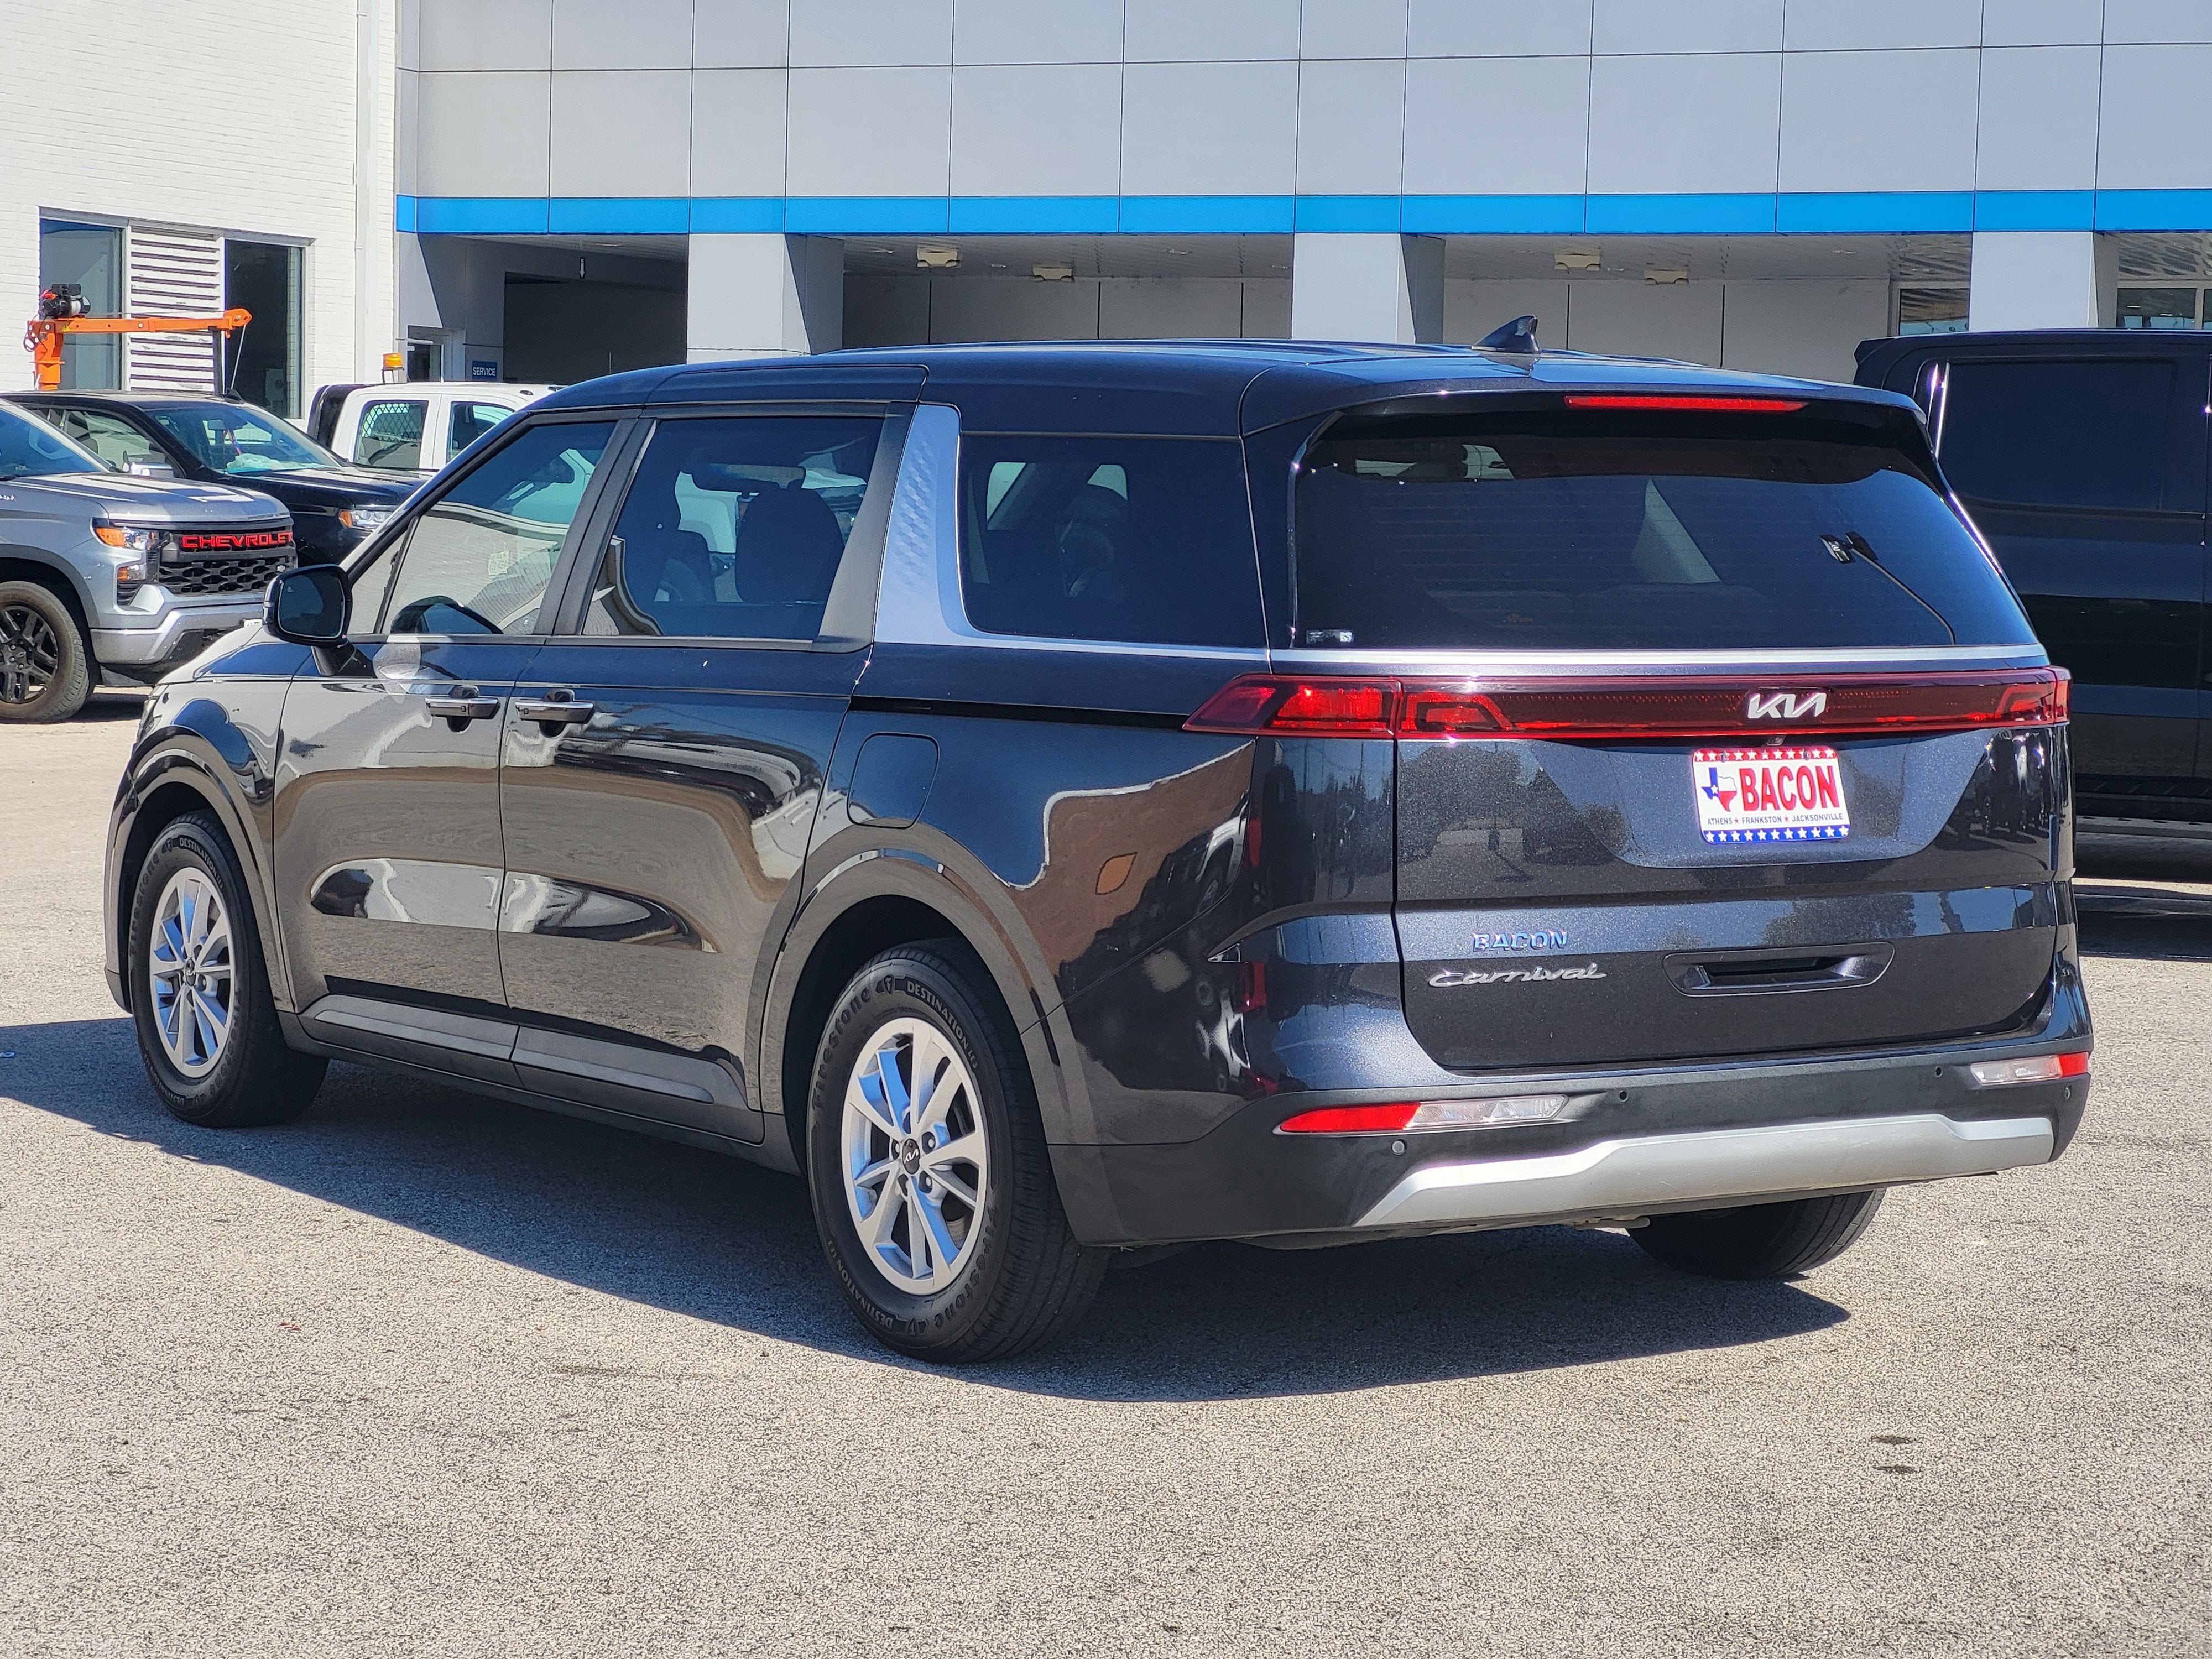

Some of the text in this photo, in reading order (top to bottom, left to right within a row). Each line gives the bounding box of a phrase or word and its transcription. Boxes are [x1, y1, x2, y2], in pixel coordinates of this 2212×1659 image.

[473, 367, 496, 376] SERVICE
[182, 531, 293, 549] CHEVROLET
[1748, 693, 1827, 719] KIA
[1739, 765, 1840, 811] BACON
[1707, 812, 1844, 826] ATHENS FRANKSTON JACKSONVILLE
[1473, 930, 1568, 952] BACON
[1428, 963, 1608, 988] Carnival
[906, 980, 969, 1050] DESTINATION
[811, 987, 870, 1110] Firestone
[836, 1259, 893, 1329] DESTINATION
